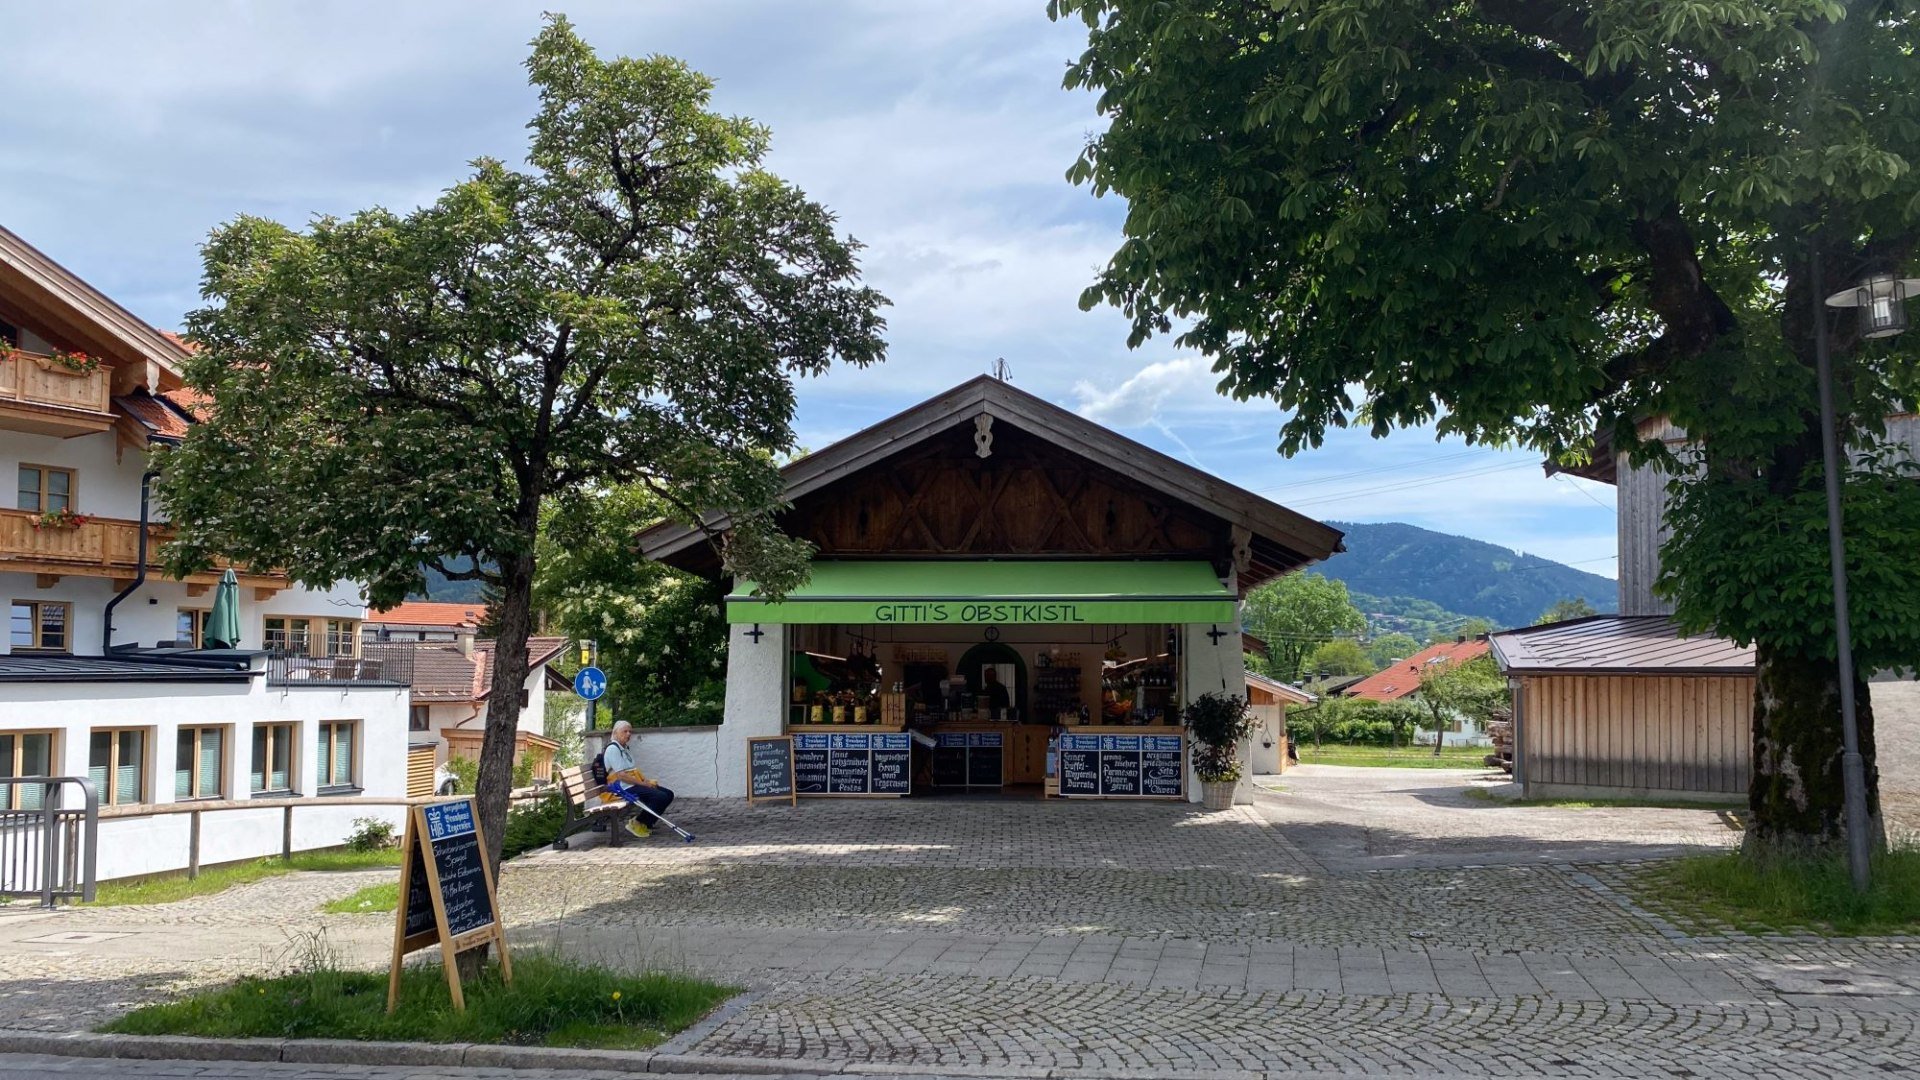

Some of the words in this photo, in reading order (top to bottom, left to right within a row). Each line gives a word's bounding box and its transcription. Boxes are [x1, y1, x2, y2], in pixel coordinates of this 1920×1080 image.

[875, 603, 949, 621] GITTI'S
[961, 605, 1085, 622] OBSTKISTL
[753, 742, 773, 751] Frisch
[795, 752, 825, 761] esondere
